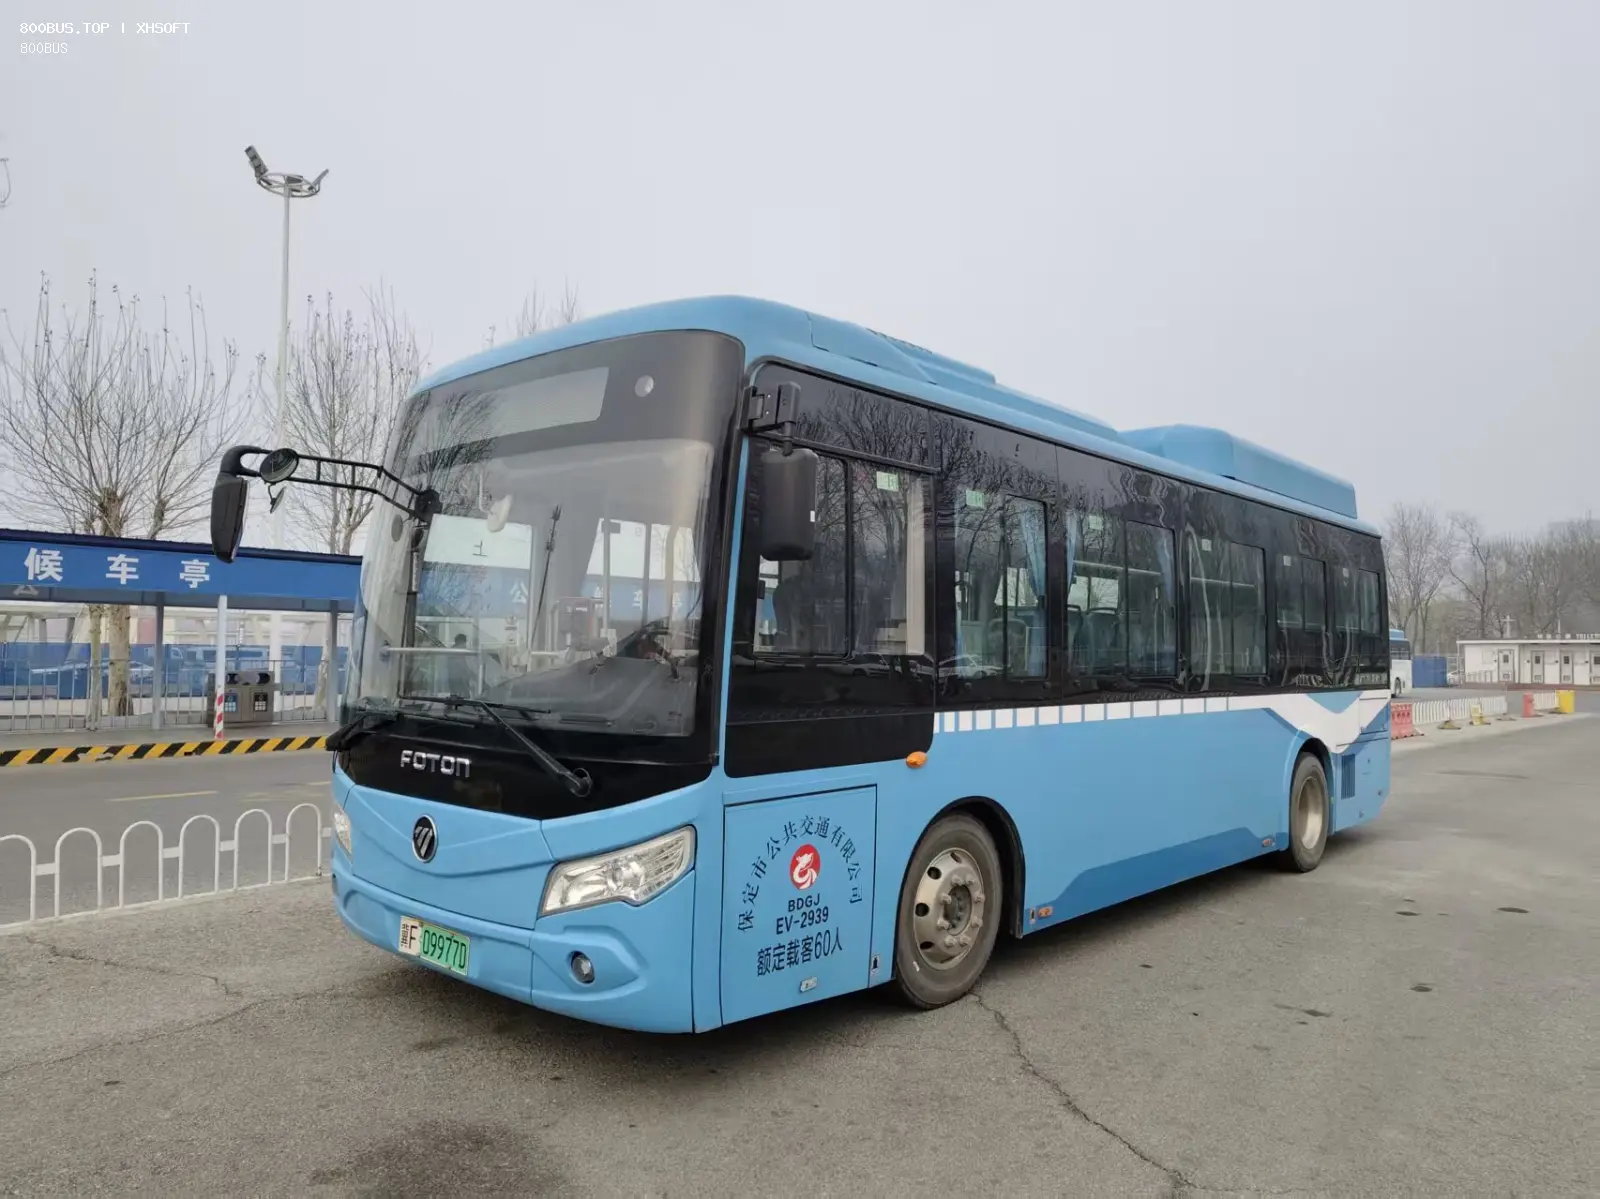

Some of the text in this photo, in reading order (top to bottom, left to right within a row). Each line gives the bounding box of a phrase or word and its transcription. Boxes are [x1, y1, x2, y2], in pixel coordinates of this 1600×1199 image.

[24, 547, 210, 589] 候车亭
[400, 749, 471, 778] FOTON
[737, 814, 863, 932] 保定市公共交通有限公司
[787, 892, 821, 913] BDGJ
[775, 906, 830, 935] EV-2939
[756, 926, 844, 977] 额定载客60人
